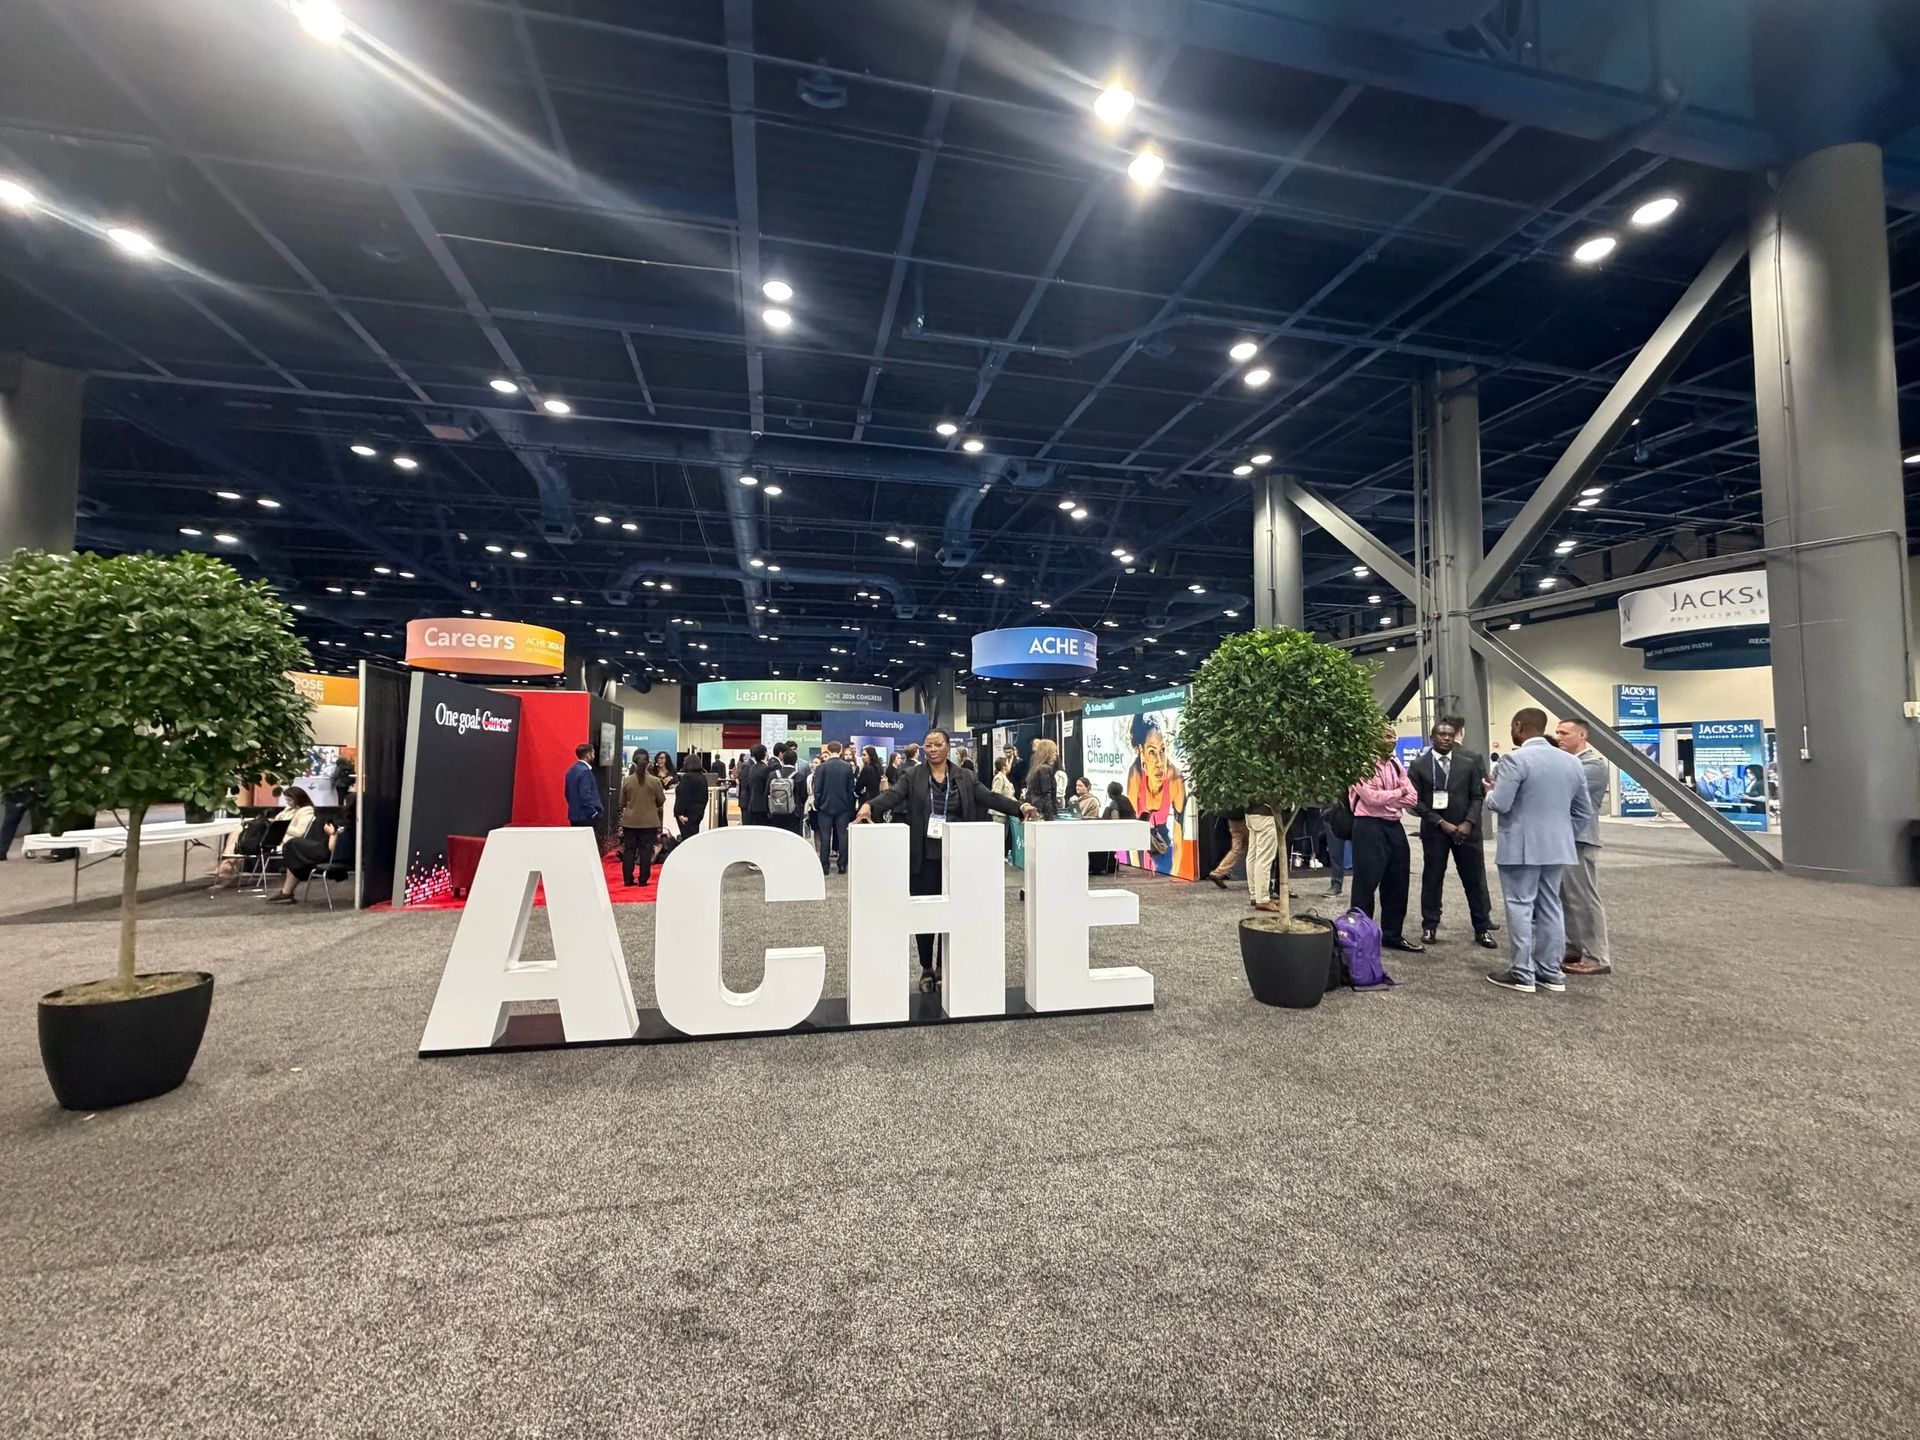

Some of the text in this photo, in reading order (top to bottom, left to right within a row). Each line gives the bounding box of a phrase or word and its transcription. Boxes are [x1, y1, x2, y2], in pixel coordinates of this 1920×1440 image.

[424, 626, 515, 650] Careers
[1028, 636, 1079, 656] ACHE
[735, 688, 796, 705] Learning
[856, 693, 883, 702] CONGRESS
[435, 702, 512, 735] One goal: Cancer
[865, 719, 904, 731] Membership
[632, 733, 649, 741] Learn
[1698, 723, 1754, 735] JACKSON
[1086, 734, 1102, 749] Life
[1087, 749, 1124, 767] Changer
[420, 820, 1154, 1050] ACHE
